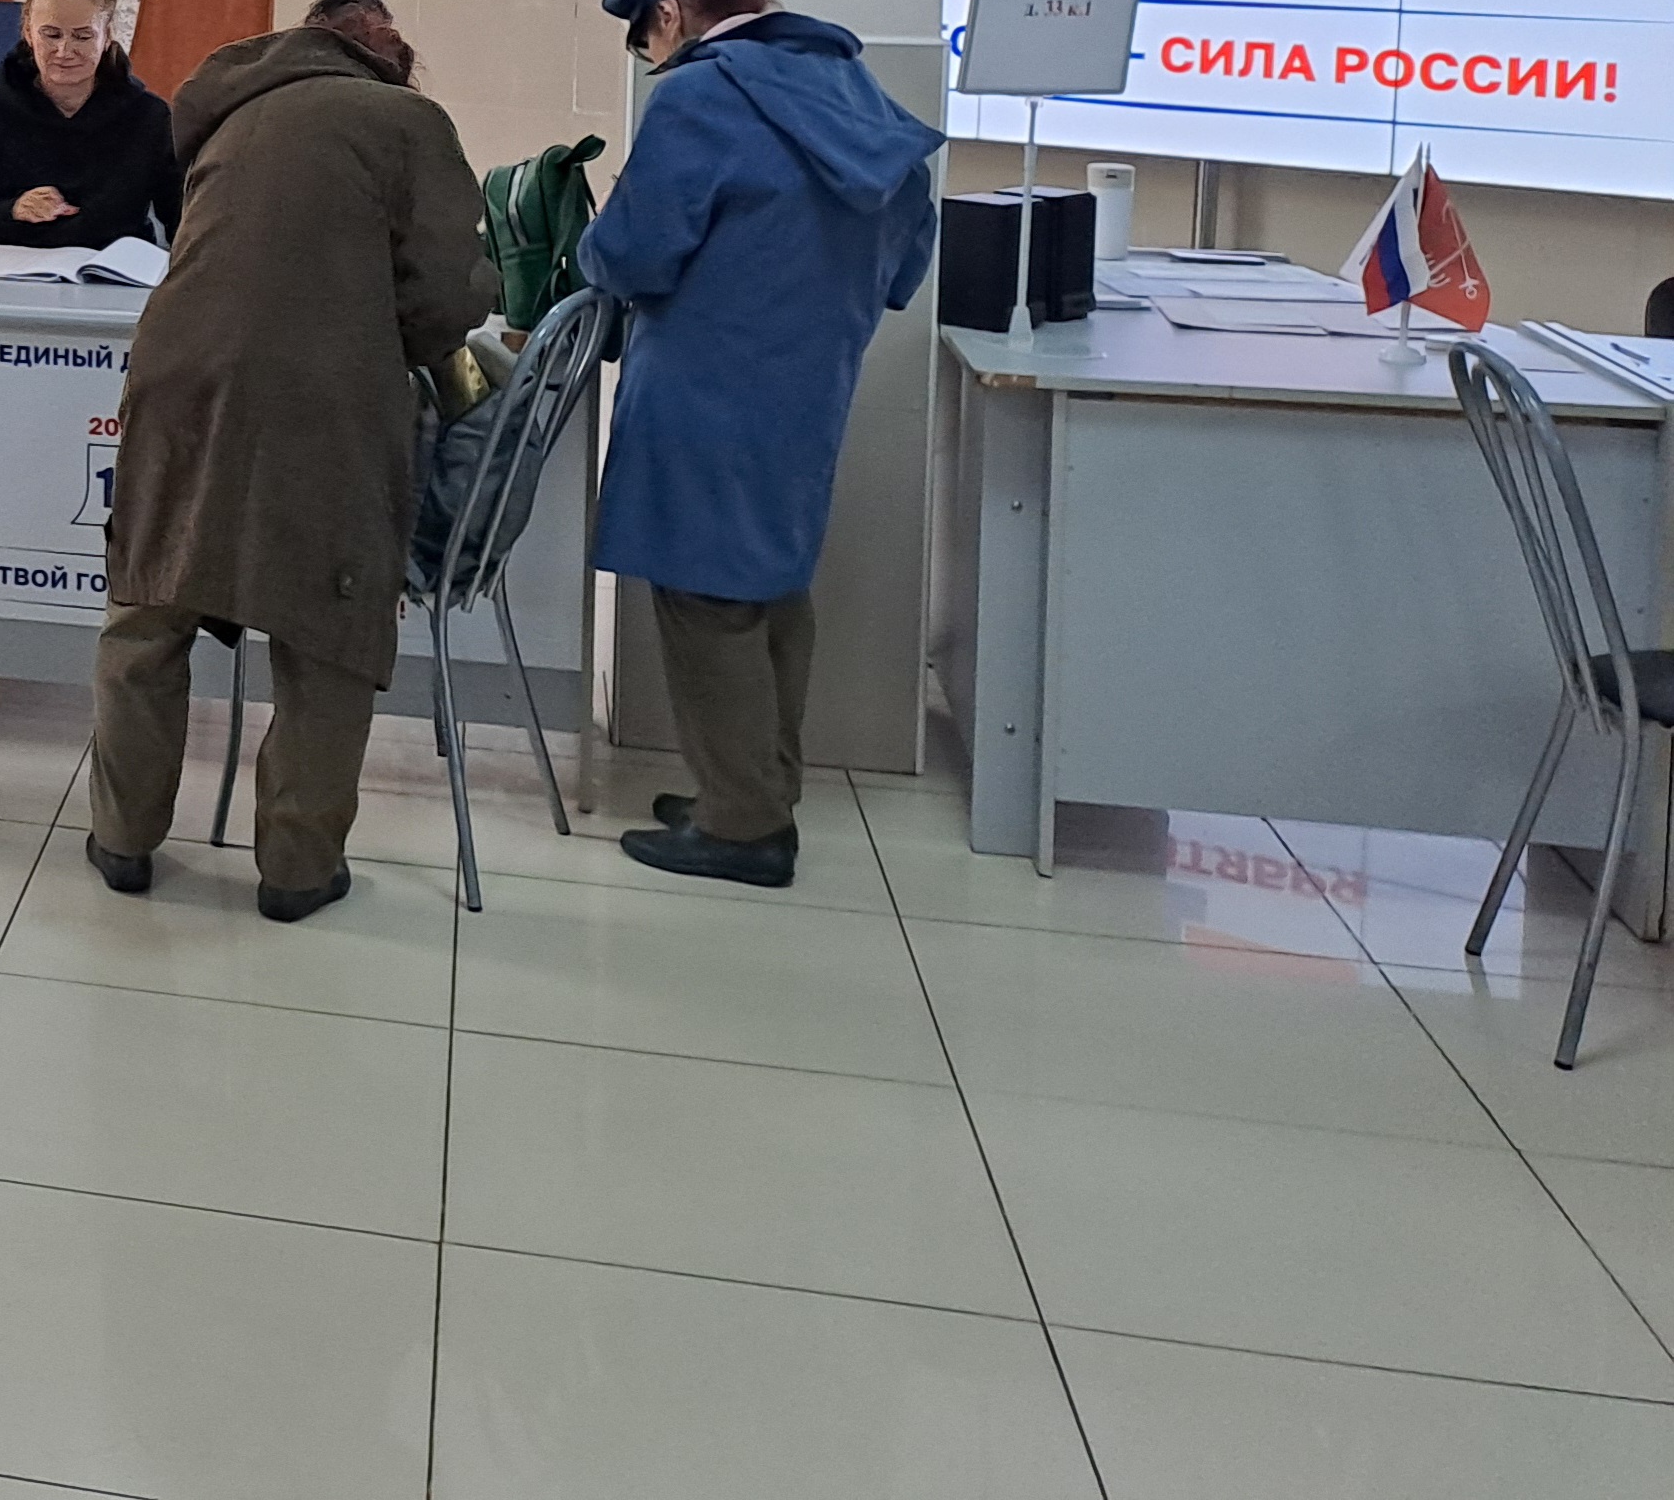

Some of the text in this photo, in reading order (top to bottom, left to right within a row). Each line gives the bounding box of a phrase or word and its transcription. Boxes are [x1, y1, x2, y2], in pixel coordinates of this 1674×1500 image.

[1161, 37, 1315, 82] СИЛА
[1335, 48, 1617, 103] РОССИИ!
[0, 344, 113, 369] ЕДИНЫЙ
